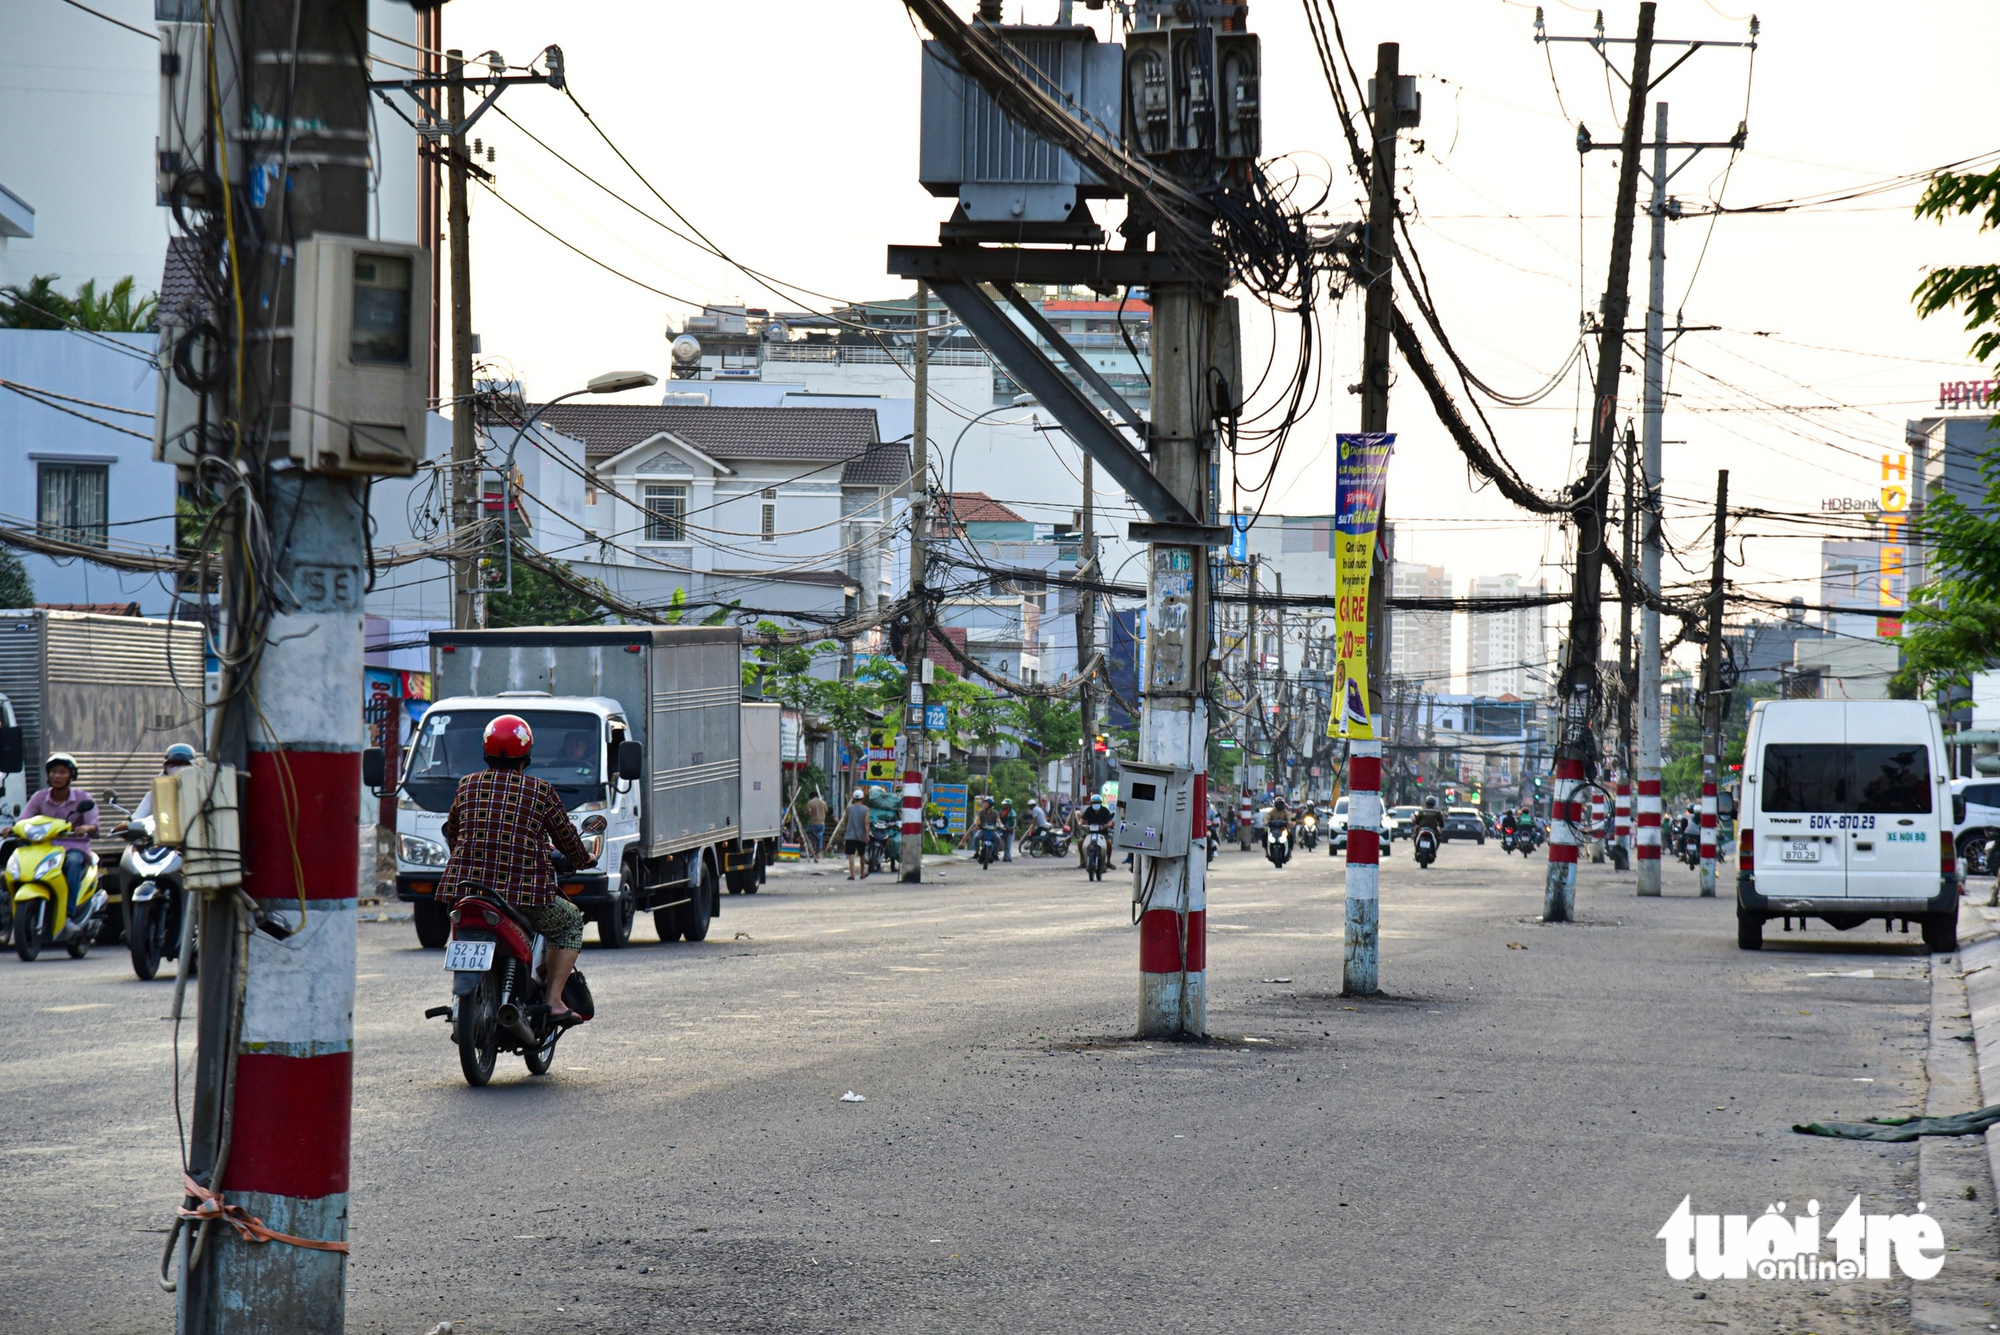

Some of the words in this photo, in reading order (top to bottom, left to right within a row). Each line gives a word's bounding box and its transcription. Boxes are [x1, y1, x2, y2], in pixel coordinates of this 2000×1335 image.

[1940, 380, 2000, 404] HOTE
[1821, 497, 1879, 511] HDBank
[1880, 454, 1906, 607] HOTEL
[927, 711, 945, 726] 722
[1792, 842, 1808, 851] 60K
[451, 956, 484, 968] 4104
